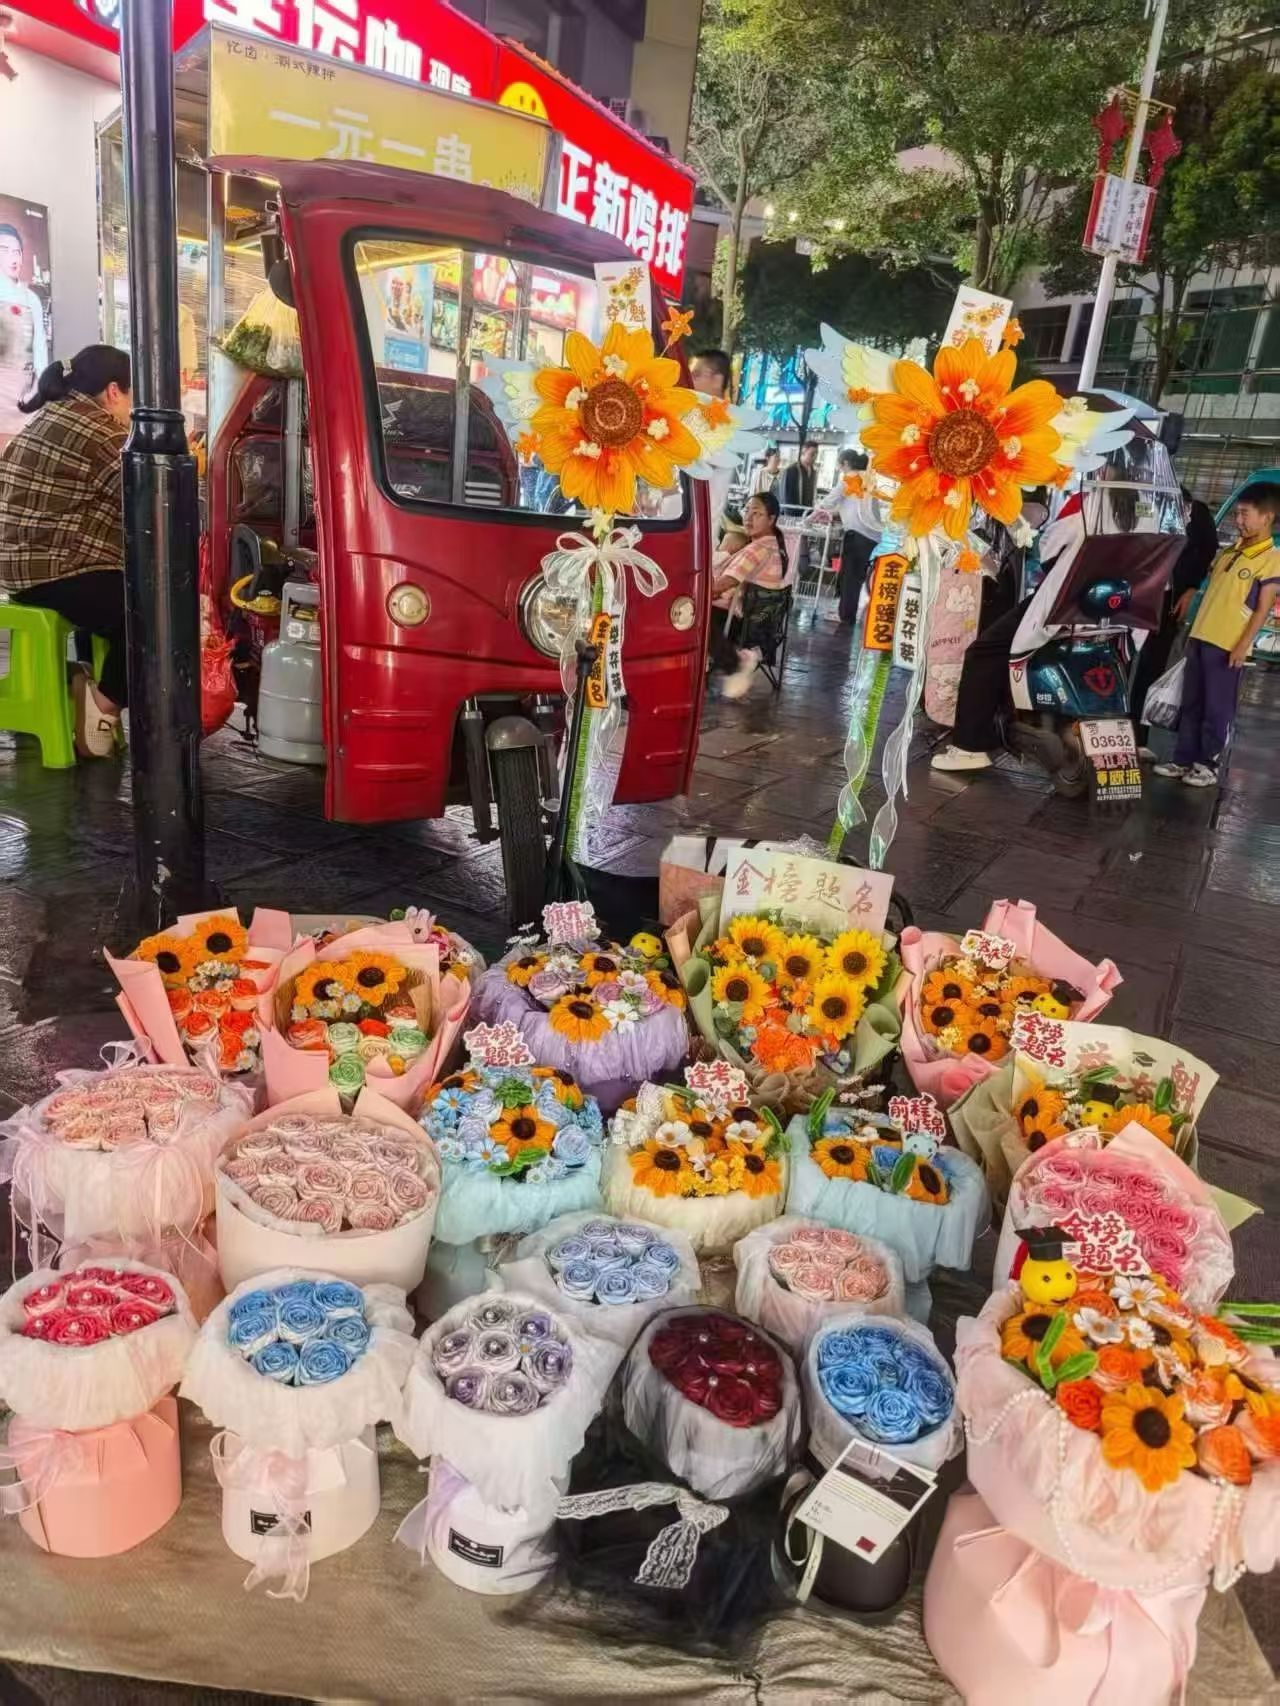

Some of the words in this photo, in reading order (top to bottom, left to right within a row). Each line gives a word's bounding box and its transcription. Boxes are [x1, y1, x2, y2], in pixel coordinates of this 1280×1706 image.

[557, 140, 689, 277] 正新鸡排
[872, 560, 903, 644] 金榜题名
[1090, 734, 1132, 749] 03632
[731, 858, 873, 914] 金榜题名
[1016, 1012, 1065, 1045] 金榜
[1020, 1035, 1067, 1068] 题名
[688, 1062, 731, 1088] 逢考
[890, 1095, 933, 1119] 前程
[903, 1112, 945, 1137] 似锦
[1053, 1212, 1123, 1246] 金榜
[1076, 1243, 1141, 1273] 题名
